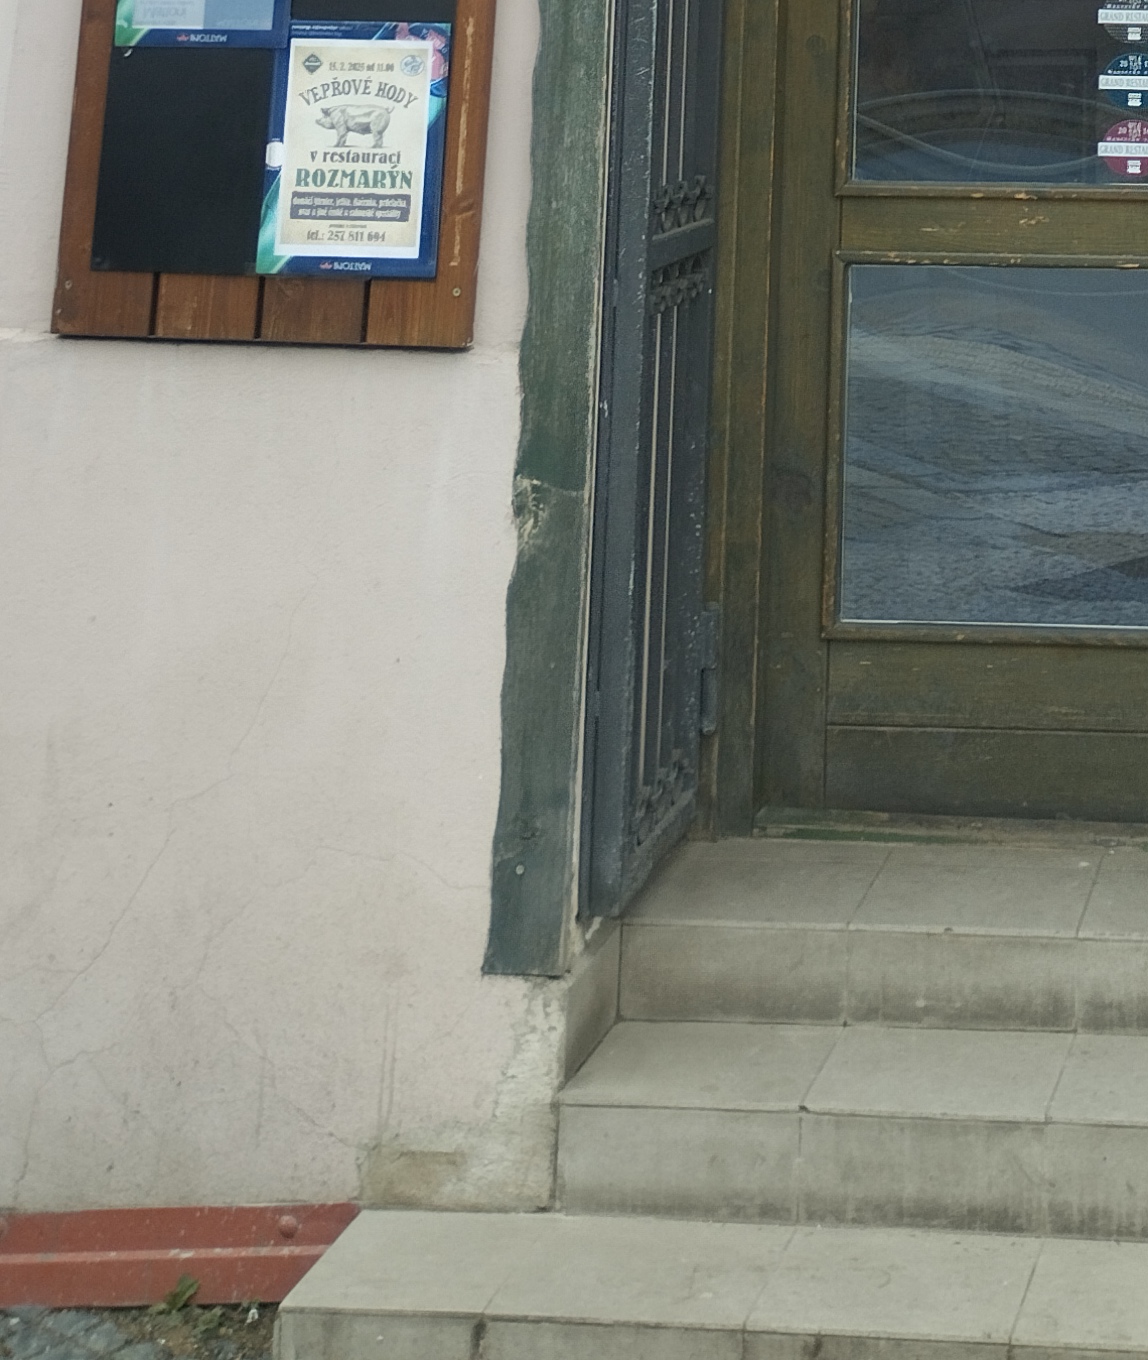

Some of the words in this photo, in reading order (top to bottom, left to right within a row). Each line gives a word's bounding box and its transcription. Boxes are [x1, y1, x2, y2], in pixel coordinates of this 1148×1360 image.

[1100, 12, 1125, 22] GRAND
[1101, 78, 1125, 87] GRAND
[298, 76, 373, 106] VEPŘOVÉ
[374, 81, 419, 109] HODY
[1100, 144, 1124, 154] GRAND
[310, 151, 318, 162] v
[322, 149, 401, 164] restauraci
[294, 164, 413, 189] ROZMARÝN
[327, 230, 346, 241] 257
